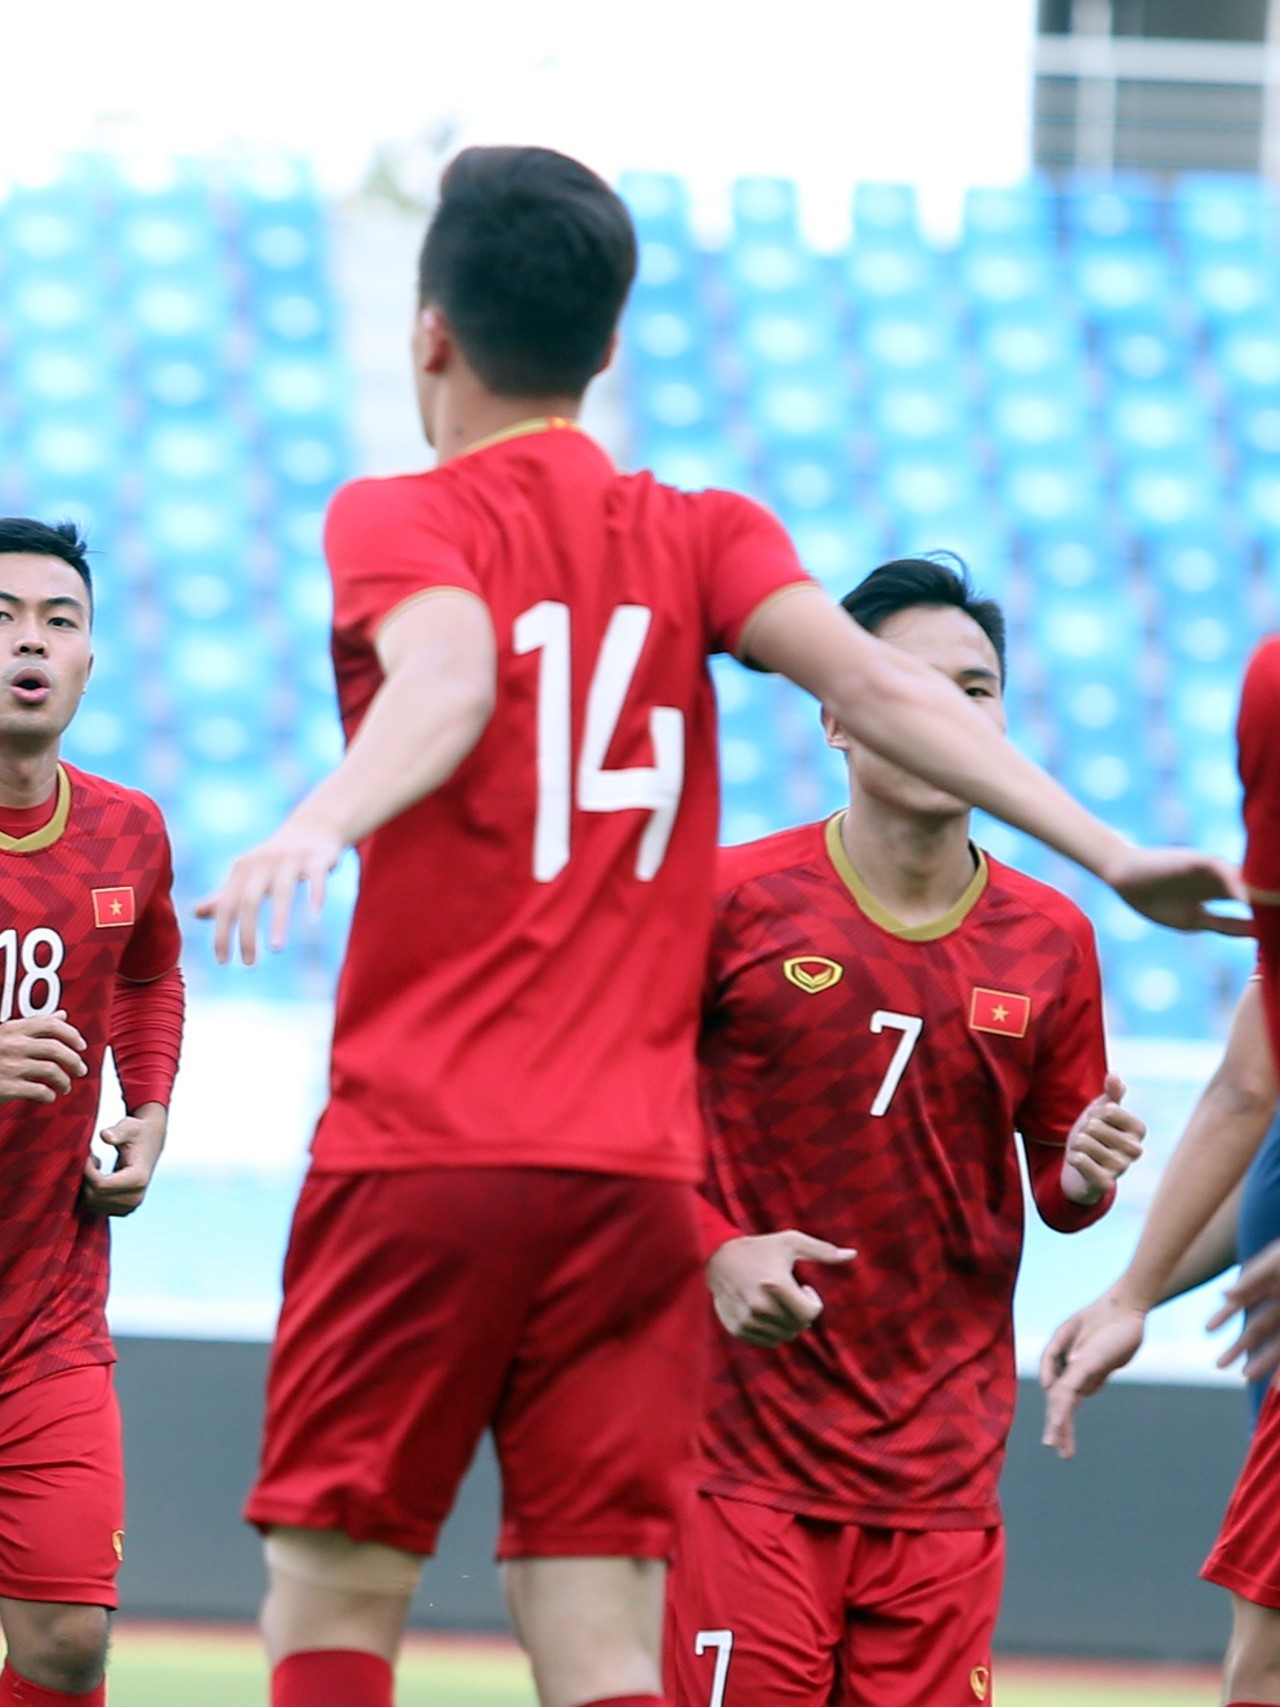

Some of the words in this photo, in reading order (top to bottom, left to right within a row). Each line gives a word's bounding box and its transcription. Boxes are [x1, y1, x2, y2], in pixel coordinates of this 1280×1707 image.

[513, 601, 684, 883] 14
[869, 1010, 923, 1117] 7
[694, 1630, 733, 1707] 7
